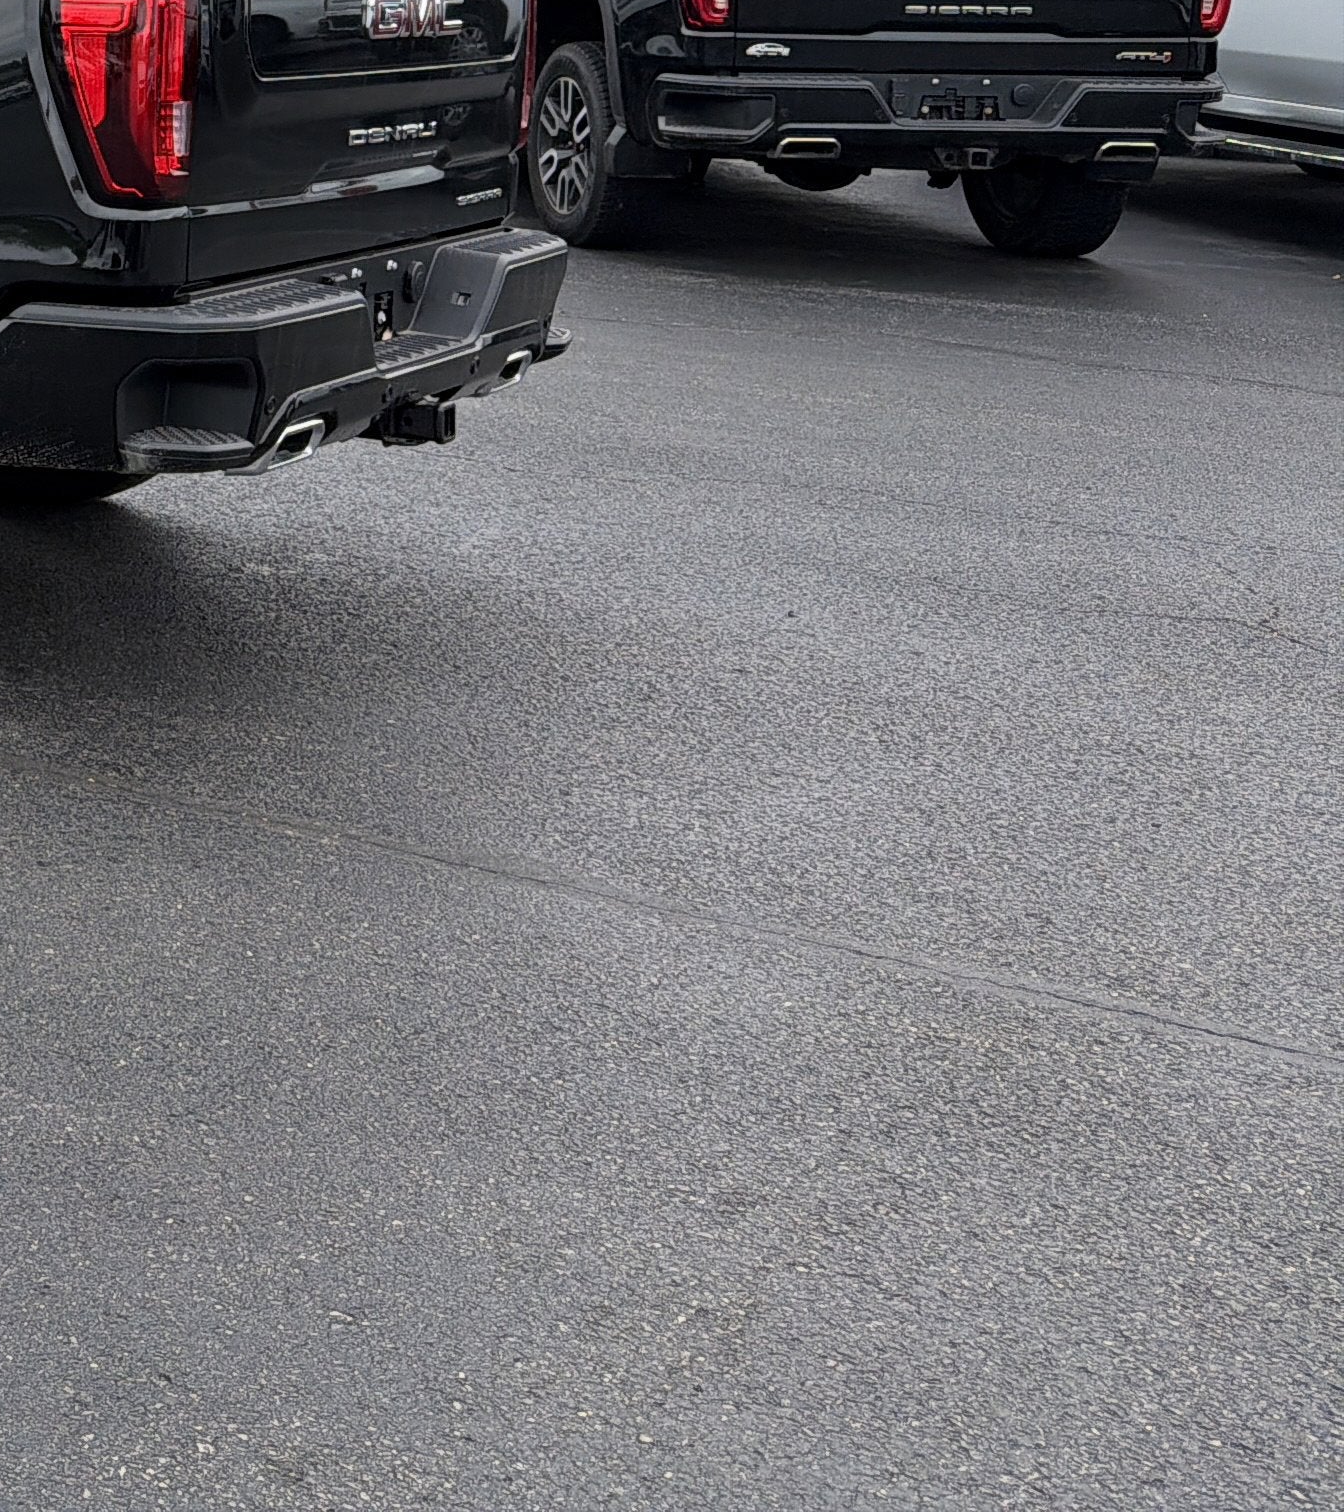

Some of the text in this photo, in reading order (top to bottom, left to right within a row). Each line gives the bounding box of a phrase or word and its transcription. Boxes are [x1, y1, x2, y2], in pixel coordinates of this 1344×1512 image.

[904, 5, 1033, 15] SIERRA
[1116, 51, 1172, 63] AT4
[348, 120, 438, 146] DENALI
